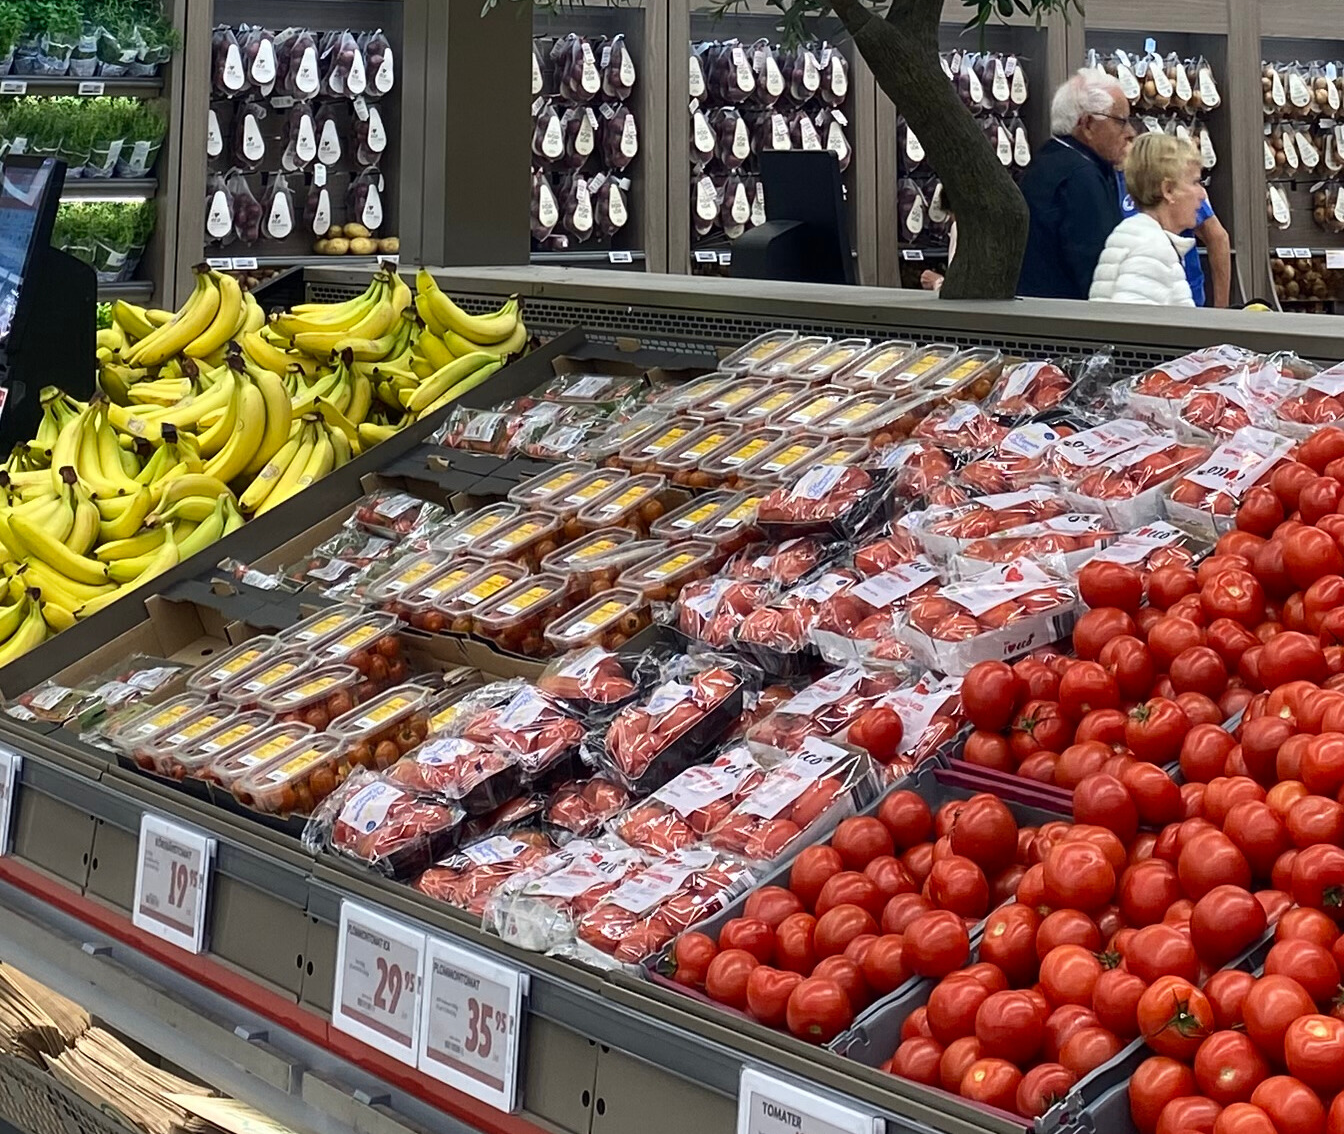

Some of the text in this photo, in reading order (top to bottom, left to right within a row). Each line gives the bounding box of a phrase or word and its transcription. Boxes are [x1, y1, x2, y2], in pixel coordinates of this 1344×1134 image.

[168, 861, 188, 908] 19
[374, 957, 403, 1015] 29
[404, 971, 416, 993] 95
[465, 997, 494, 1058] 35
[495, 1011, 507, 1034] 95
[762, 1101, 802, 1130] TOMATER
